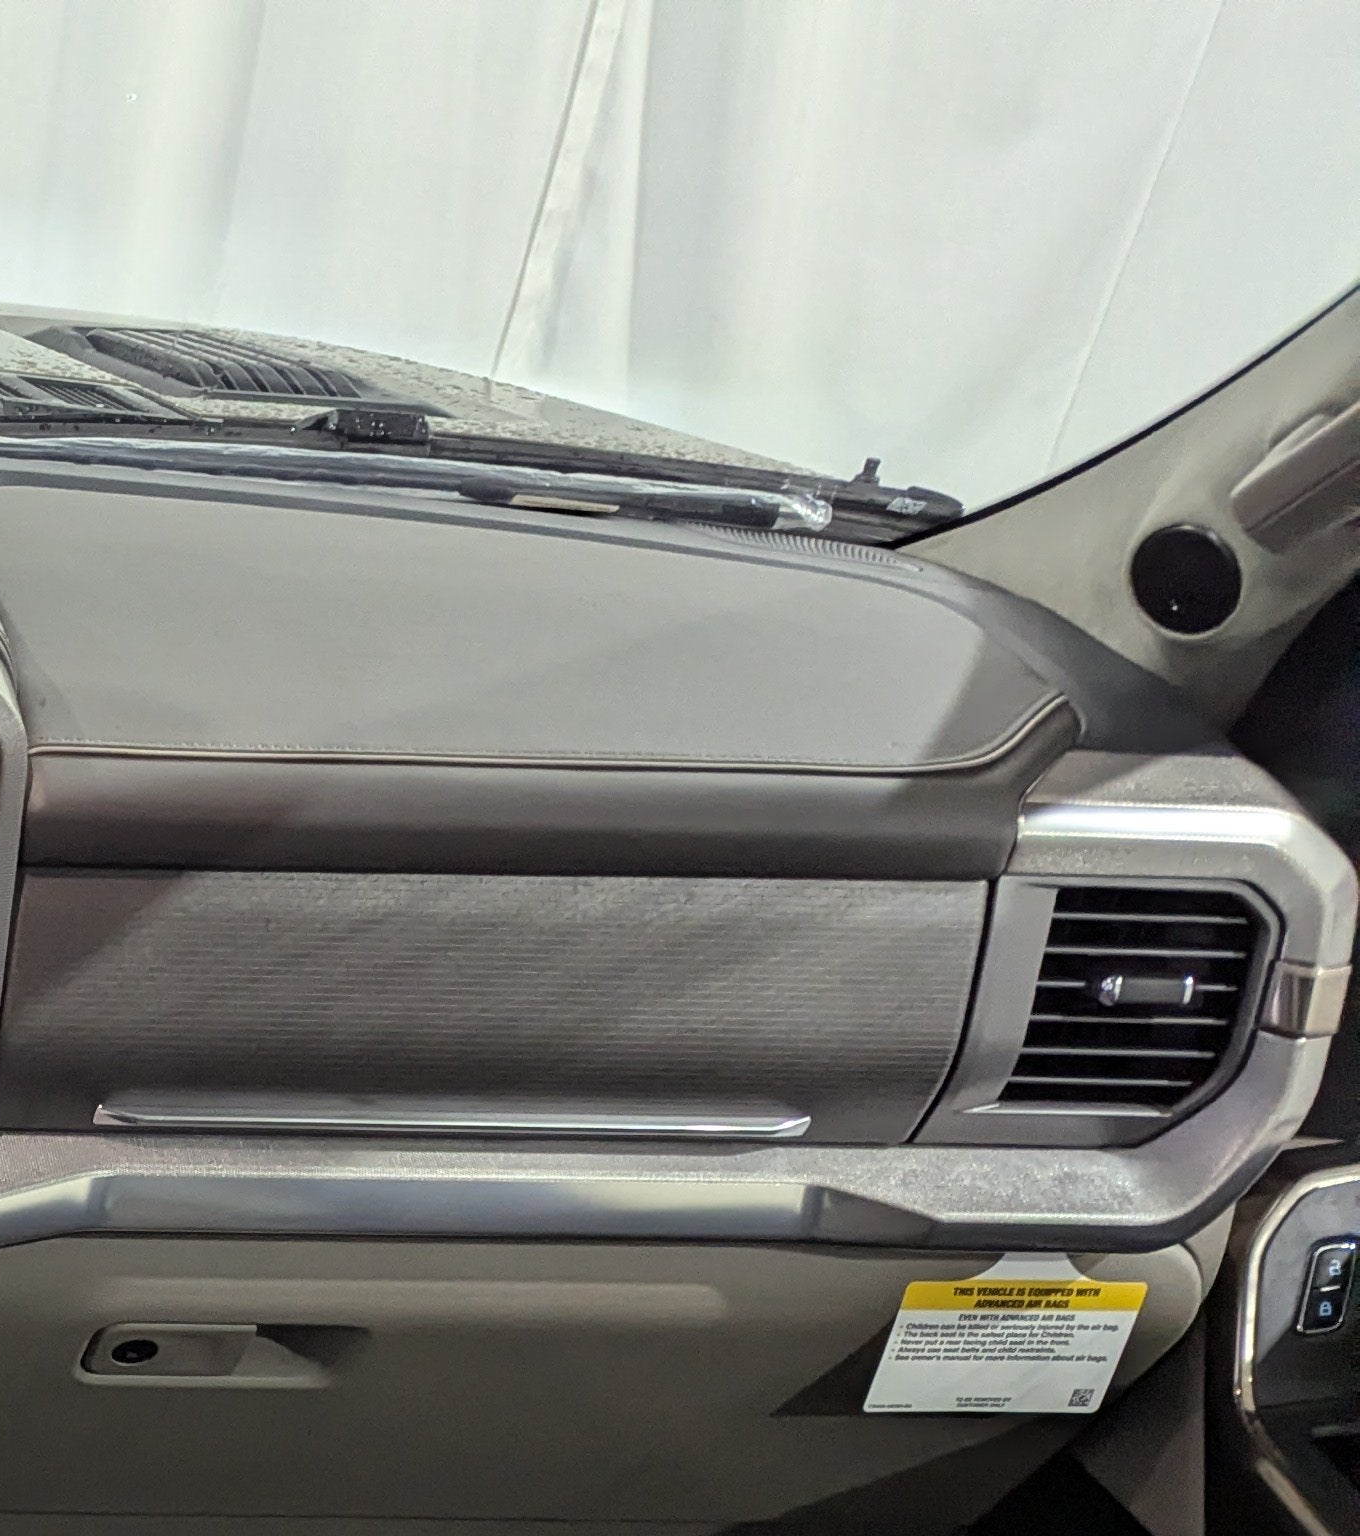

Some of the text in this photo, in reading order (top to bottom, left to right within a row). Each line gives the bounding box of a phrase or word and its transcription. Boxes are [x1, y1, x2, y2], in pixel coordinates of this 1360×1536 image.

[953, 1287, 1101, 1297] THIS VEHICLE IS EQUIPPED WITH
[974, 1299, 1070, 1309] ADVANCED AIR BAGS
